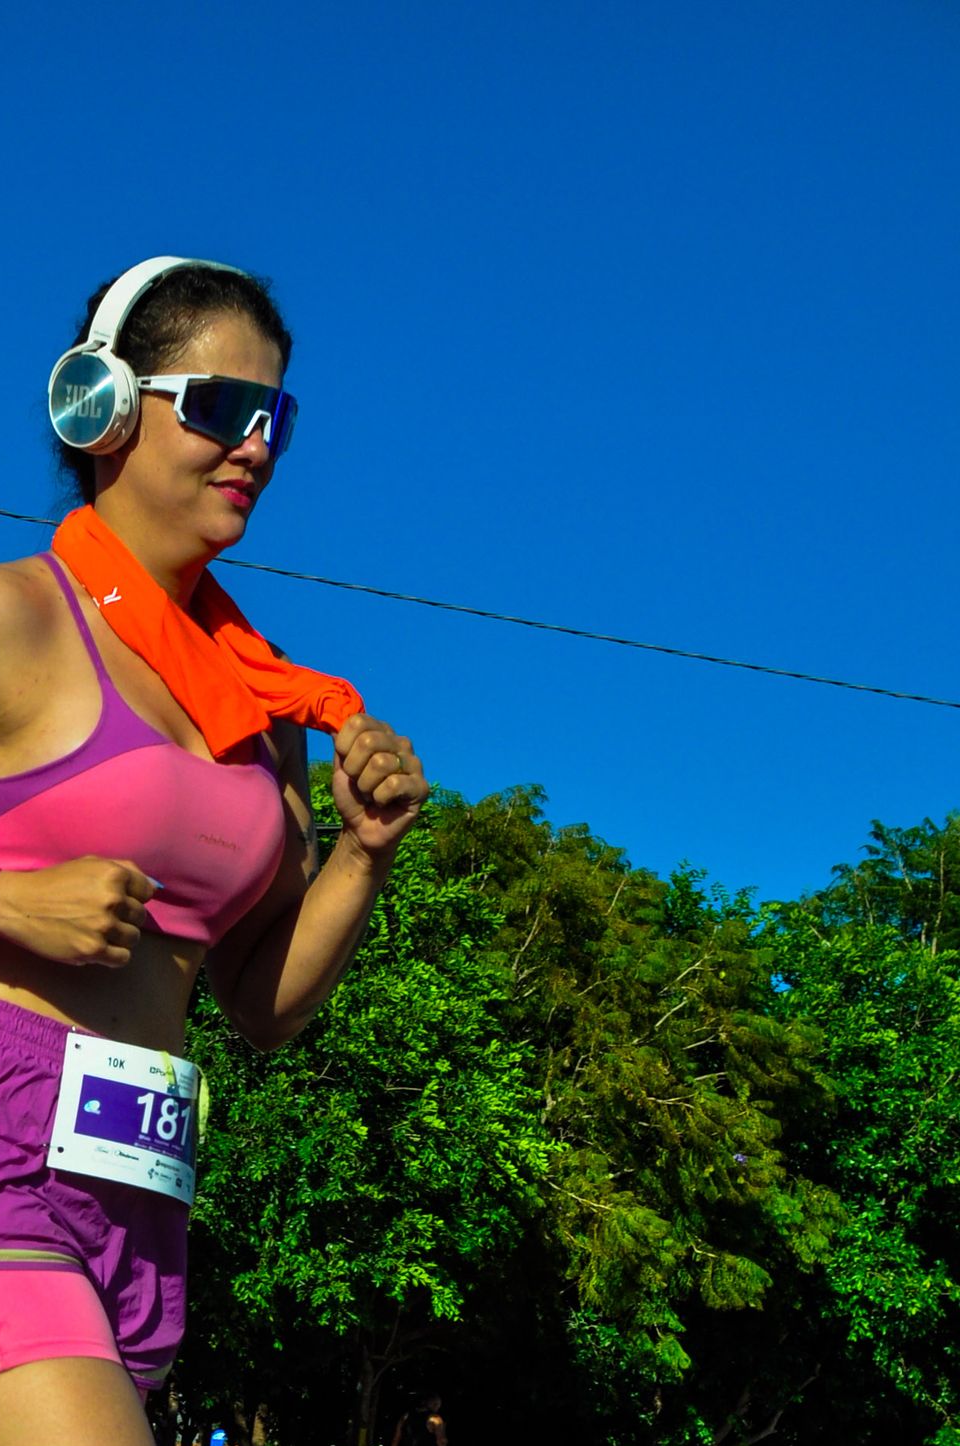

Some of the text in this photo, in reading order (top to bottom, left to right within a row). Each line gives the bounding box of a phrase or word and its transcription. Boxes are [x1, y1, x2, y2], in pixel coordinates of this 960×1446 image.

[65, 384, 102, 419] JBL
[107, 1057, 126, 1070] 10K
[137, 1092, 191, 1146] 181
